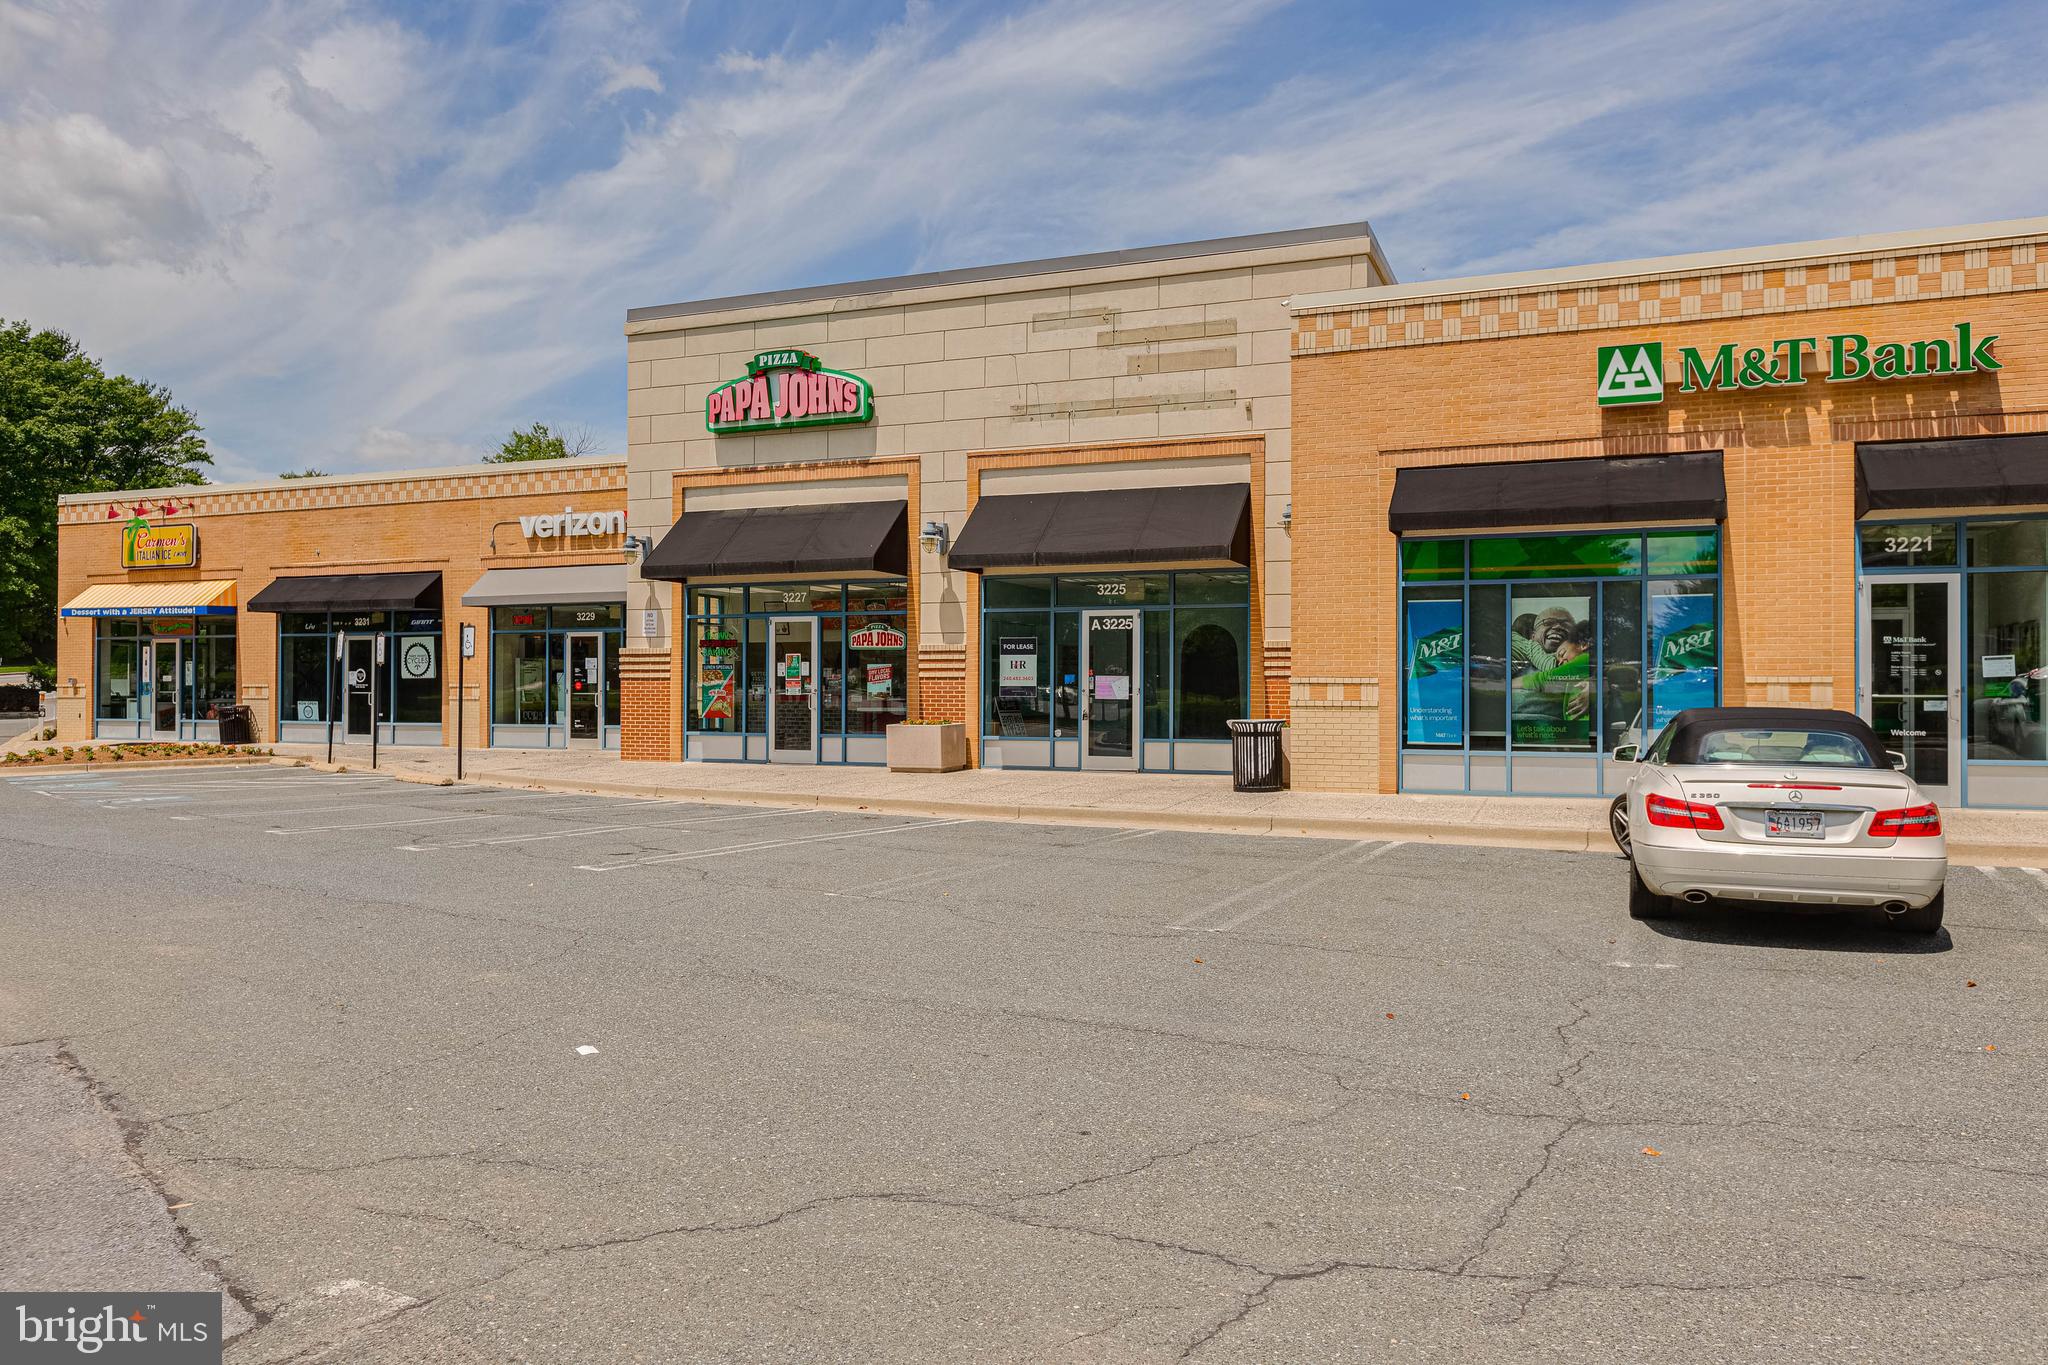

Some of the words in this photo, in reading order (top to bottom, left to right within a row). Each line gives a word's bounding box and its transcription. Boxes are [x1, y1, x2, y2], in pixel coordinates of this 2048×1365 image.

[759, 352, 798, 367] PIZZA
[1678, 337, 1819, 393] M&T
[1824, 322, 2004, 383] Bank
[708, 375, 771, 424] PAPA
[774, 373, 858, 418] JOHNS
[519, 506, 626, 538] verizon
[137, 532, 187, 549] Carmen's
[1884, 536, 1932, 552] 3221
[136, 550, 160, 560] ITALIAN
[162, 549, 172, 560] ICE
[1097, 583, 1126, 595] 3225
[782, 592, 807, 603] 3227
[103, 608, 120, 616] with
[576, 612, 596, 621] 3229
[354, 618, 370, 626] 3231
[1091, 619, 1101, 630] A
[1102, 618, 1133, 630] 3225
[852, 632, 873, 646] PAPA
[875, 631, 903, 646] JOHNS
[1418, 633, 1462, 659] M&T
[1664, 629, 1714, 658] M&T
[1409, 707, 1453, 715] Understanding
